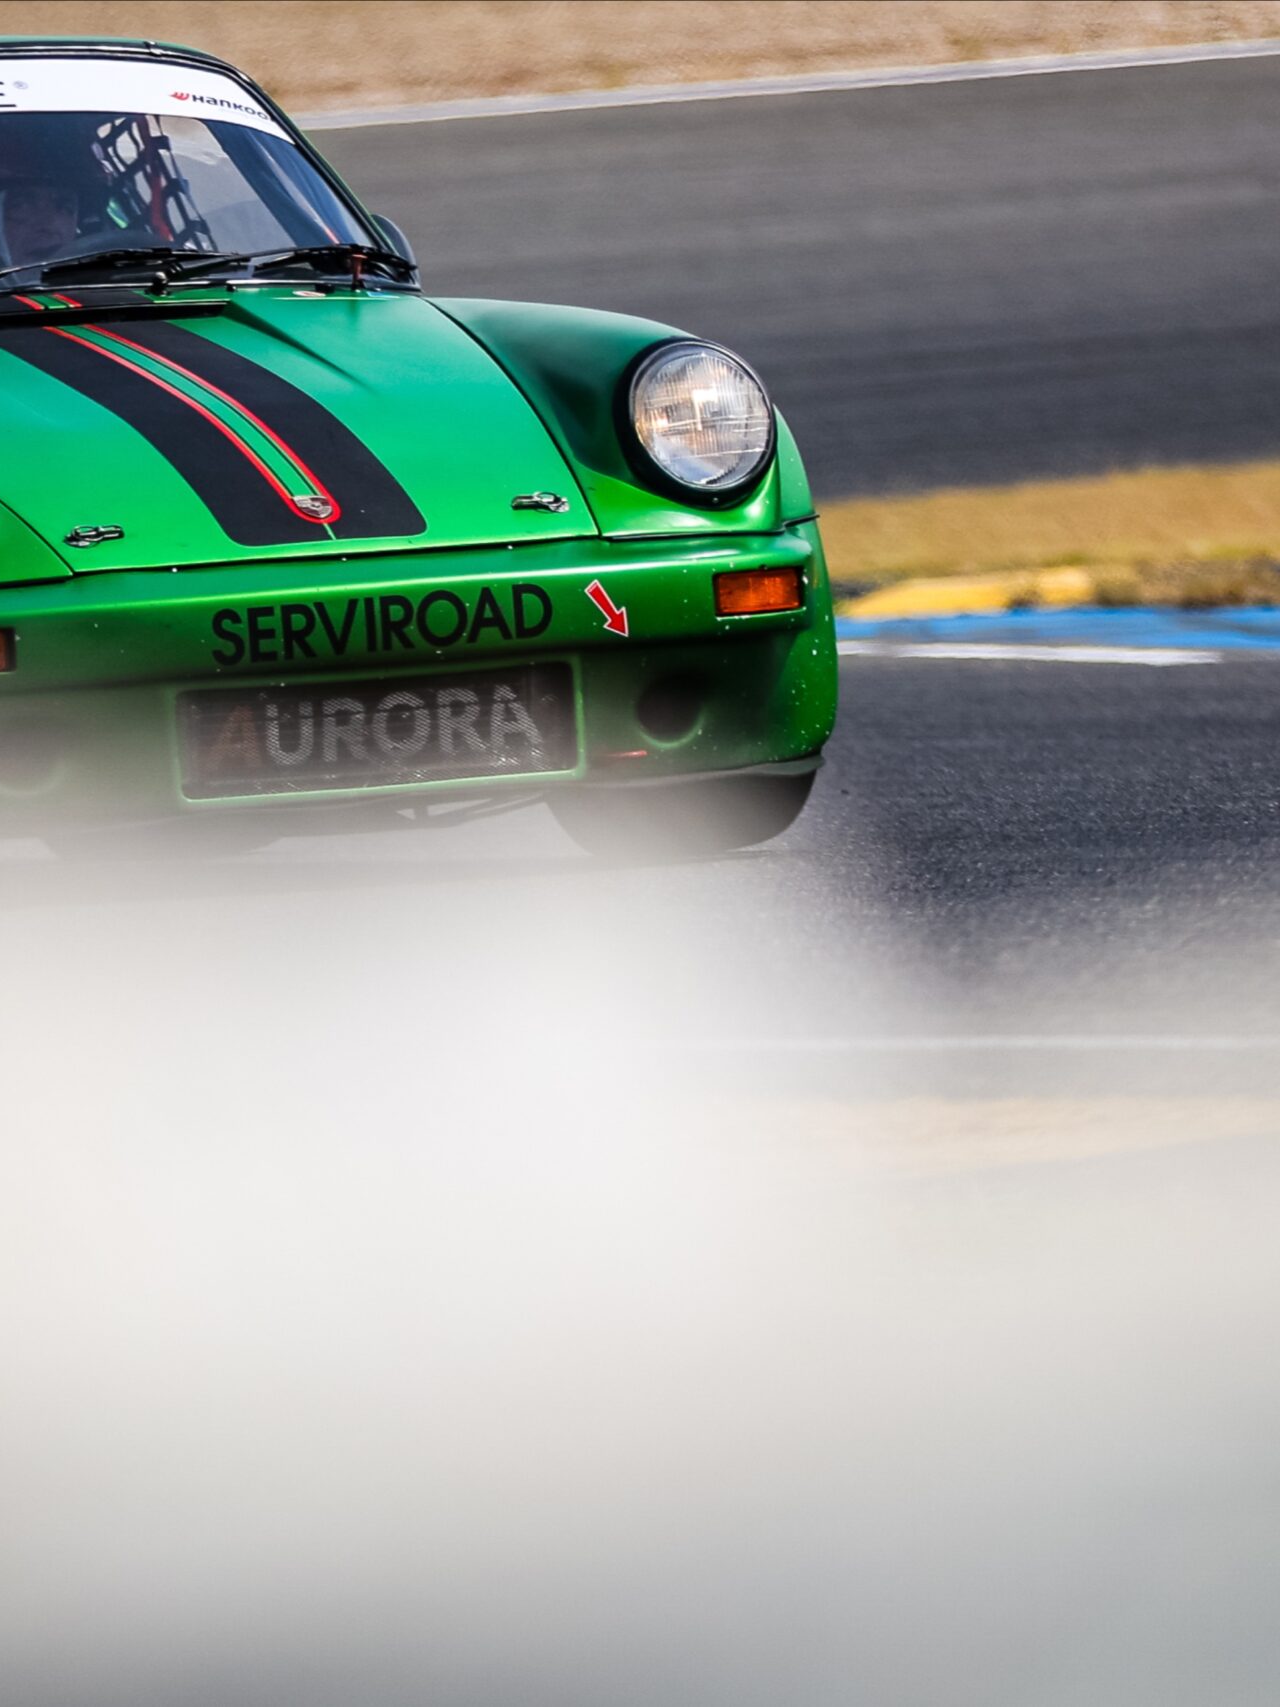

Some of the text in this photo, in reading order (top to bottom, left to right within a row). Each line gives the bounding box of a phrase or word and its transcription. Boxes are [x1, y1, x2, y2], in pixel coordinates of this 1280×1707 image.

[192, 94, 269, 121] Hankoo
[211, 583, 553, 666] SERVIROAD
[209, 683, 546, 770] AURORA
